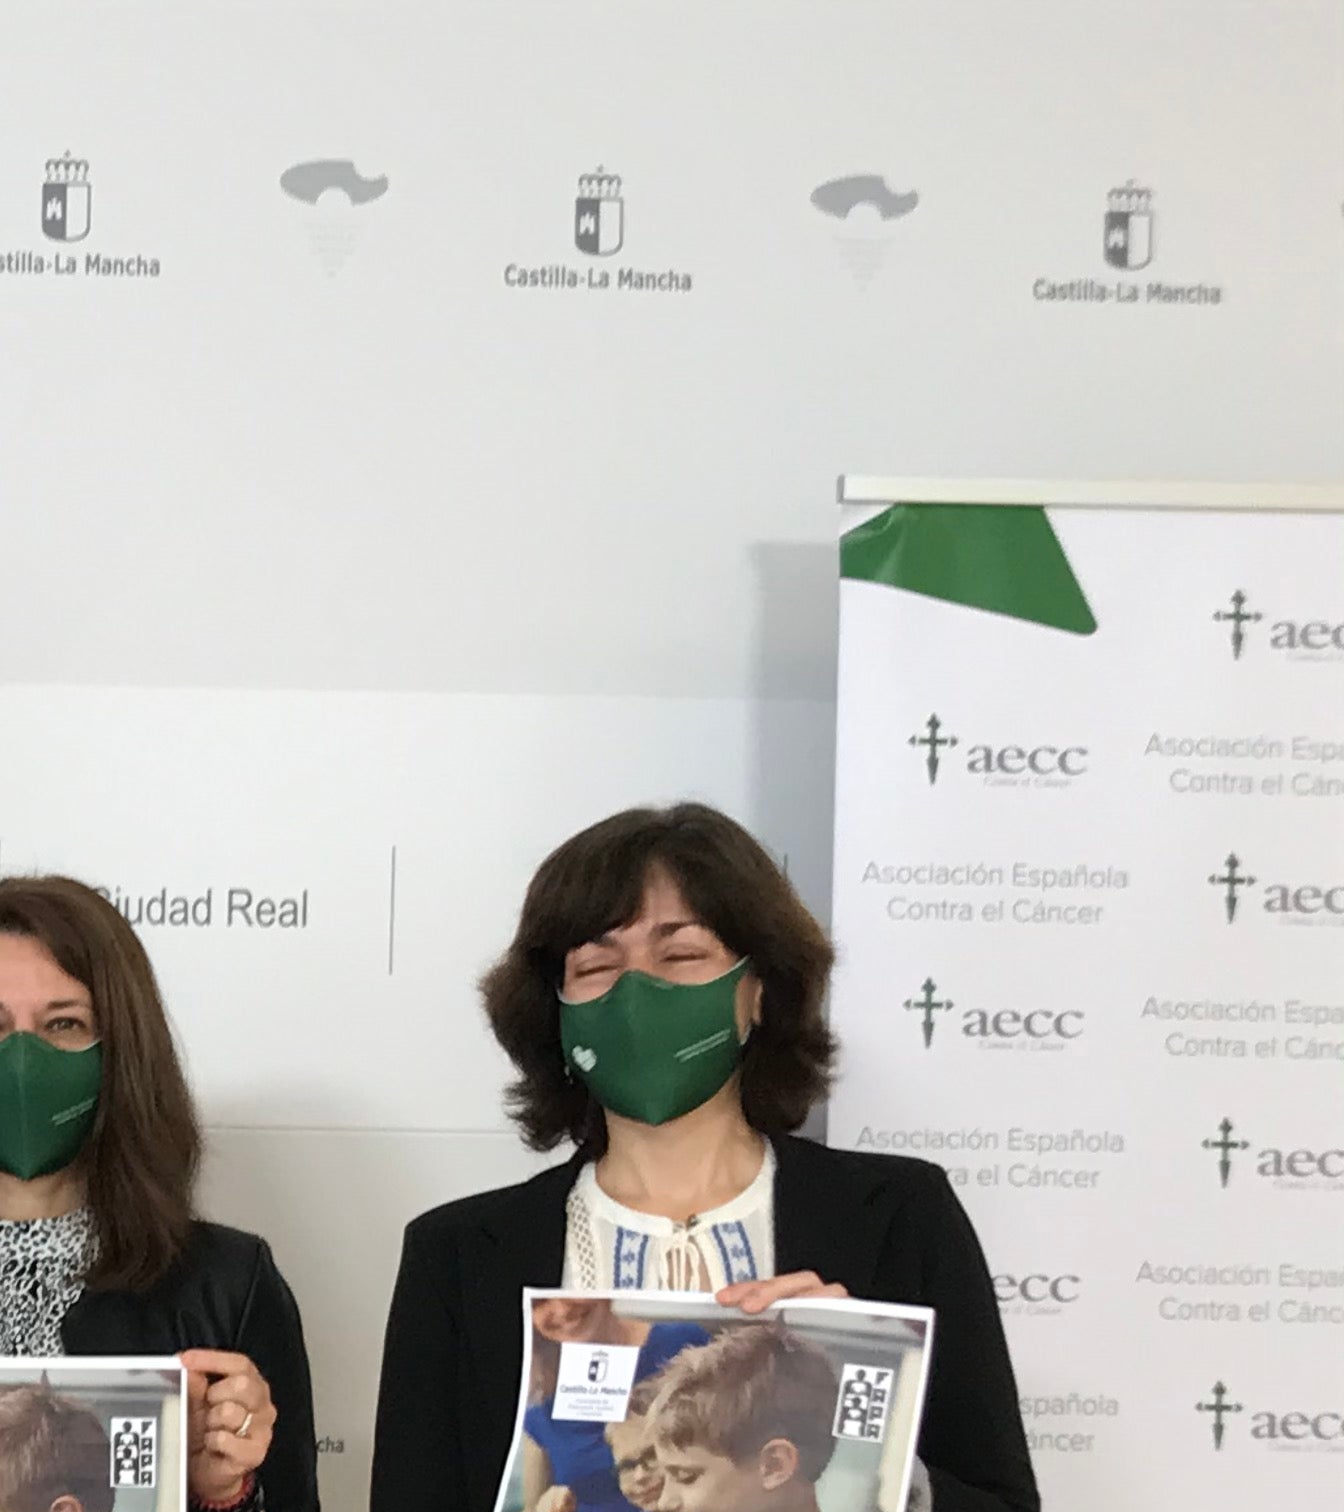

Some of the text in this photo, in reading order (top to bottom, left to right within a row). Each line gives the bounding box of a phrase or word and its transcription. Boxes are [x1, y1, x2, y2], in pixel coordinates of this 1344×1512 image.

[83, 252, 162, 279] Mancha
[503, 263, 694, 293] Castilla-La Mancha
[1032, 277, 1223, 306] Castilla-La Mancha
[967, 744, 1088, 776] aecc
[1145, 733, 1284, 760] Asociación
[1169, 768, 1253, 795] Contra
[862, 861, 1130, 891] Asociación Española
[225, 888, 309, 928] Real
[886, 898, 1104, 925] Contra el Cáncer
[962, 1008, 1084, 1039] aecc
[1140, 997, 1275, 1024] Asociación
[1165, 1032, 1245, 1058] Contra
[856, 1126, 1125, 1155] Asociación Española
[1258, 1146, 1344, 1177] aec
[977, 1165, 999, 1187] el
[1008, 1165, 1100, 1189] Cáncer
[1136, 1260, 1269, 1287] Asociación
[995, 1273, 1081, 1303] ecc
[1159, 1296, 1238, 1323] Contra
[1019, 1392, 1119, 1419] spañola
[1251, 1407, 1344, 1440] aec
